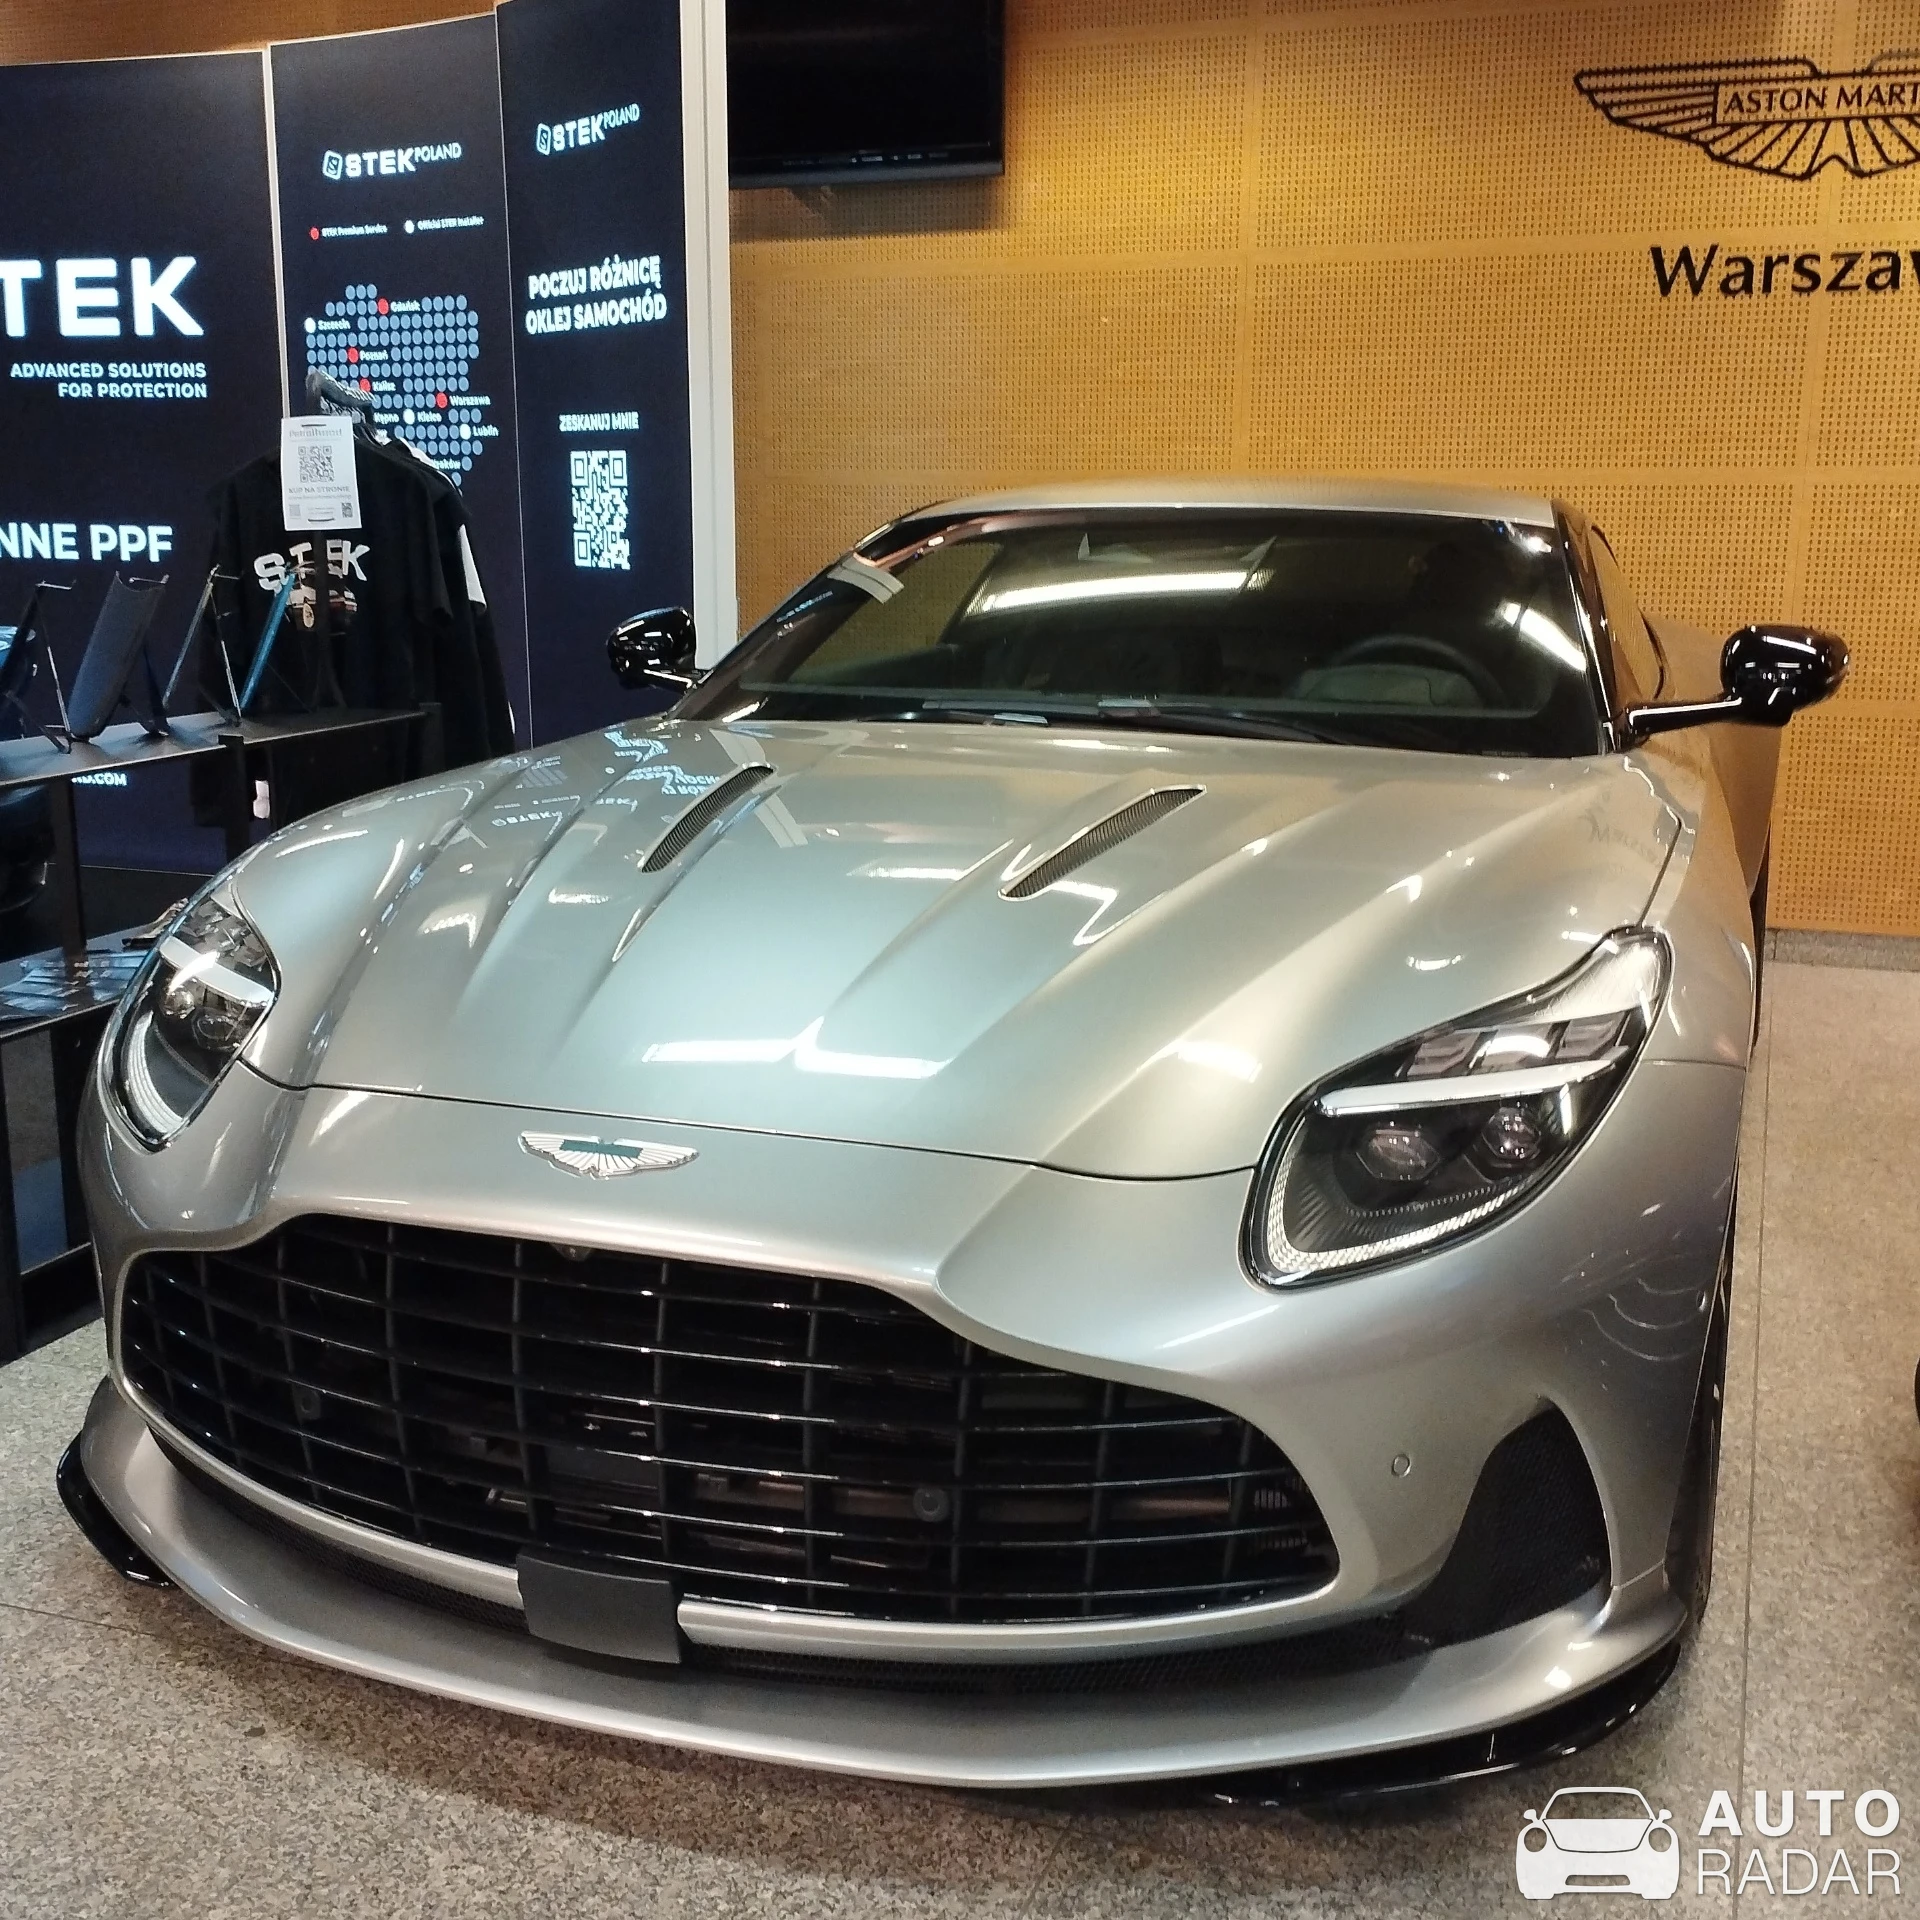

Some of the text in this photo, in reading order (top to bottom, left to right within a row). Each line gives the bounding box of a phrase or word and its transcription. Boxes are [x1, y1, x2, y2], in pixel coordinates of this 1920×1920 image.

[1724, 86, 1826, 114] ASTON
[553, 103, 640, 151] STEK POLAND
[345, 142, 462, 177] STEK POLAND
[528, 254, 662, 300] POCZUJ RÓŻNICĘ
[1650, 243, 1920, 297] Warsza
[0, 256, 204, 337] TEK
[525, 288, 668, 335] OKLEJ SAMOCHÓD
[10, 363, 207, 378] ADVANCED SOLUTIONS
[58, 383, 208, 398] FOR PROTECTION
[449, 395, 491, 406] Warszawa
[472, 424, 499, 437] Lublin
[559, 411, 639, 432] ZESKANUJ MNIE
[0, 522, 173, 563] NNE PPF
